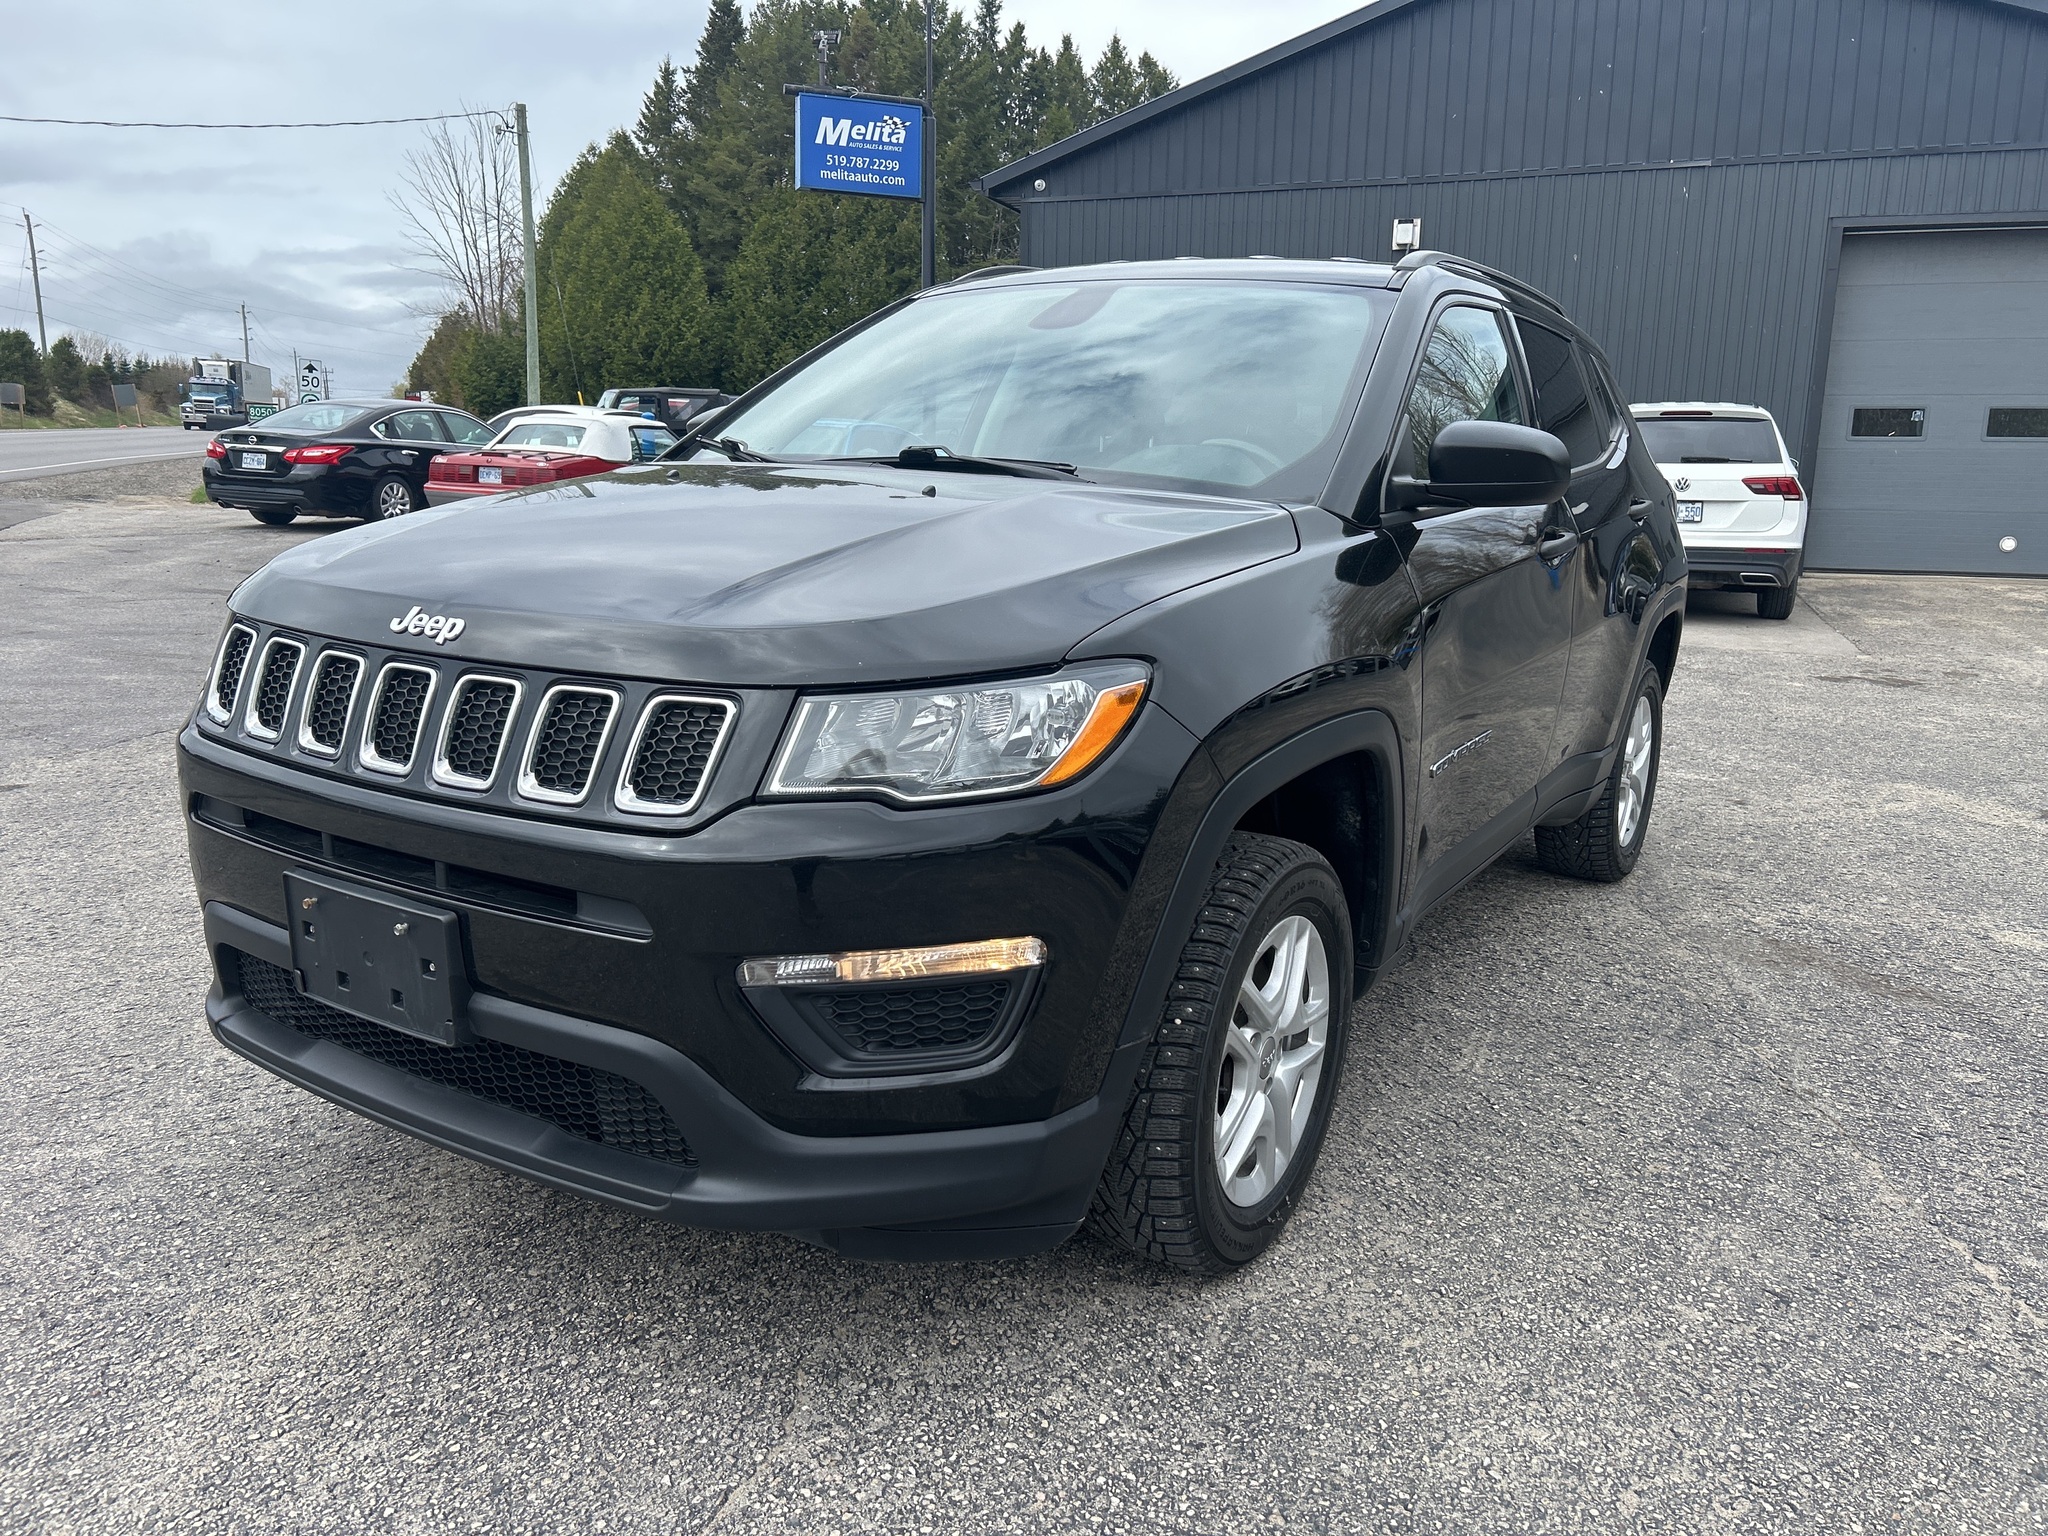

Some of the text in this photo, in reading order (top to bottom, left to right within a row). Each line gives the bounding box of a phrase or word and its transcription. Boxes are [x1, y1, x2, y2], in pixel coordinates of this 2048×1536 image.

[815, 117, 907, 147] Melita
[849, 141, 863, 149] AUTO
[863, 142, 879, 150] SALES
[882, 144, 903, 153] SERVICE
[826, 154, 899, 171] 519.787.2299
[820, 168, 905, 186] melitaauto.com
[301, 375, 320, 388] 50
[249, 407, 273, 417] 8050
[389, 605, 466, 646] Jeep
